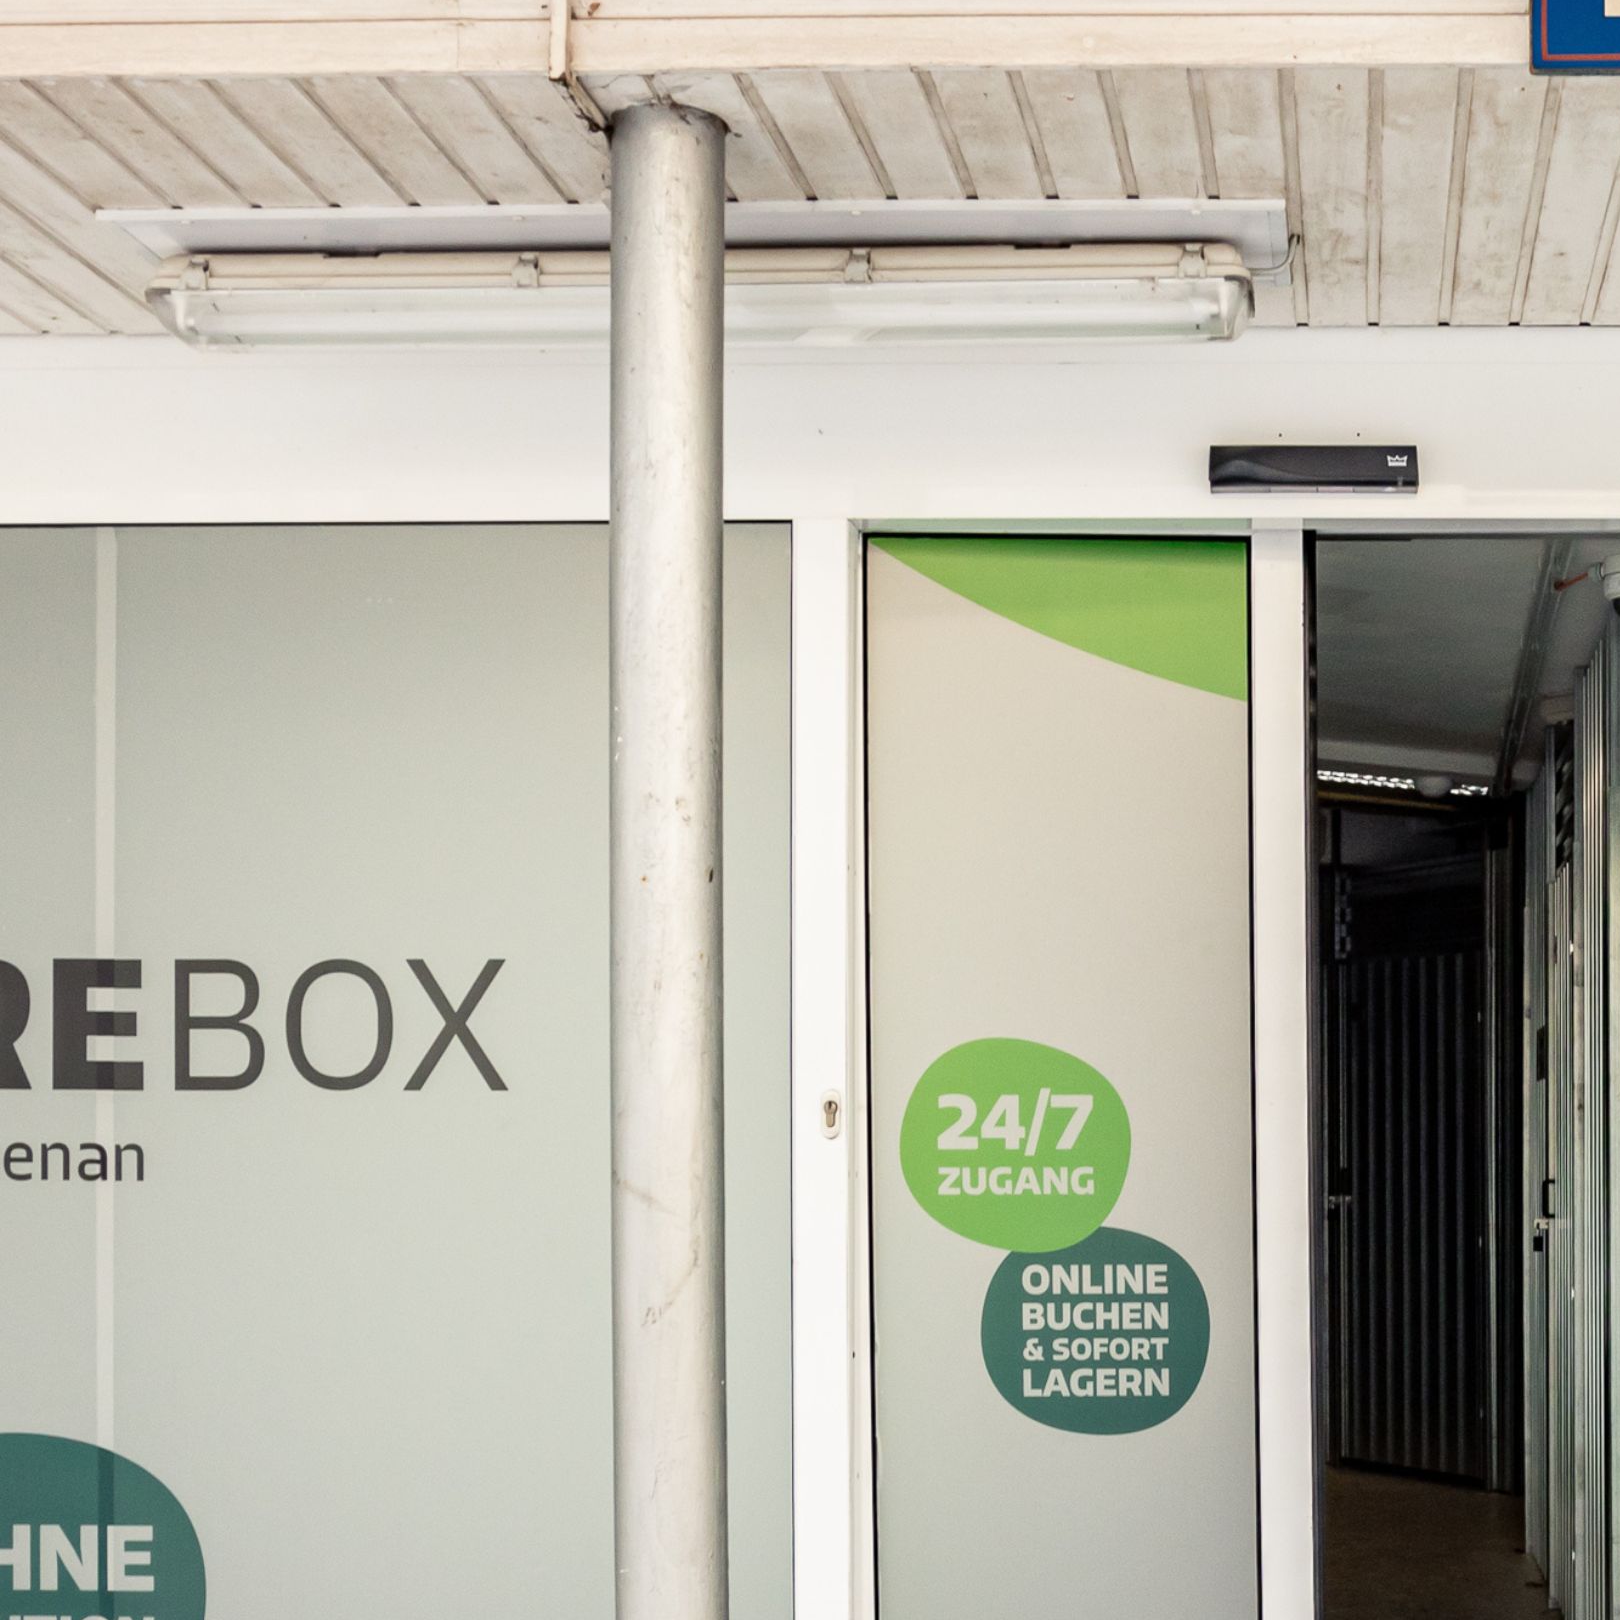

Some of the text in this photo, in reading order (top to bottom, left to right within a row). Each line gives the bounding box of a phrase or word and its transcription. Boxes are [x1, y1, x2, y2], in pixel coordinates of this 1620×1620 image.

[937, 1087, 1095, 1157] 24/7
[937, 1166, 1095, 1196] ZUGANG
[1021, 1264, 1169, 1295] ONLINE
[1021, 1302, 1169, 1331] BUCHEN
[1022, 1337, 1170, 1361] & SOFORT
[1022, 1368, 1170, 1398] LAGERN
